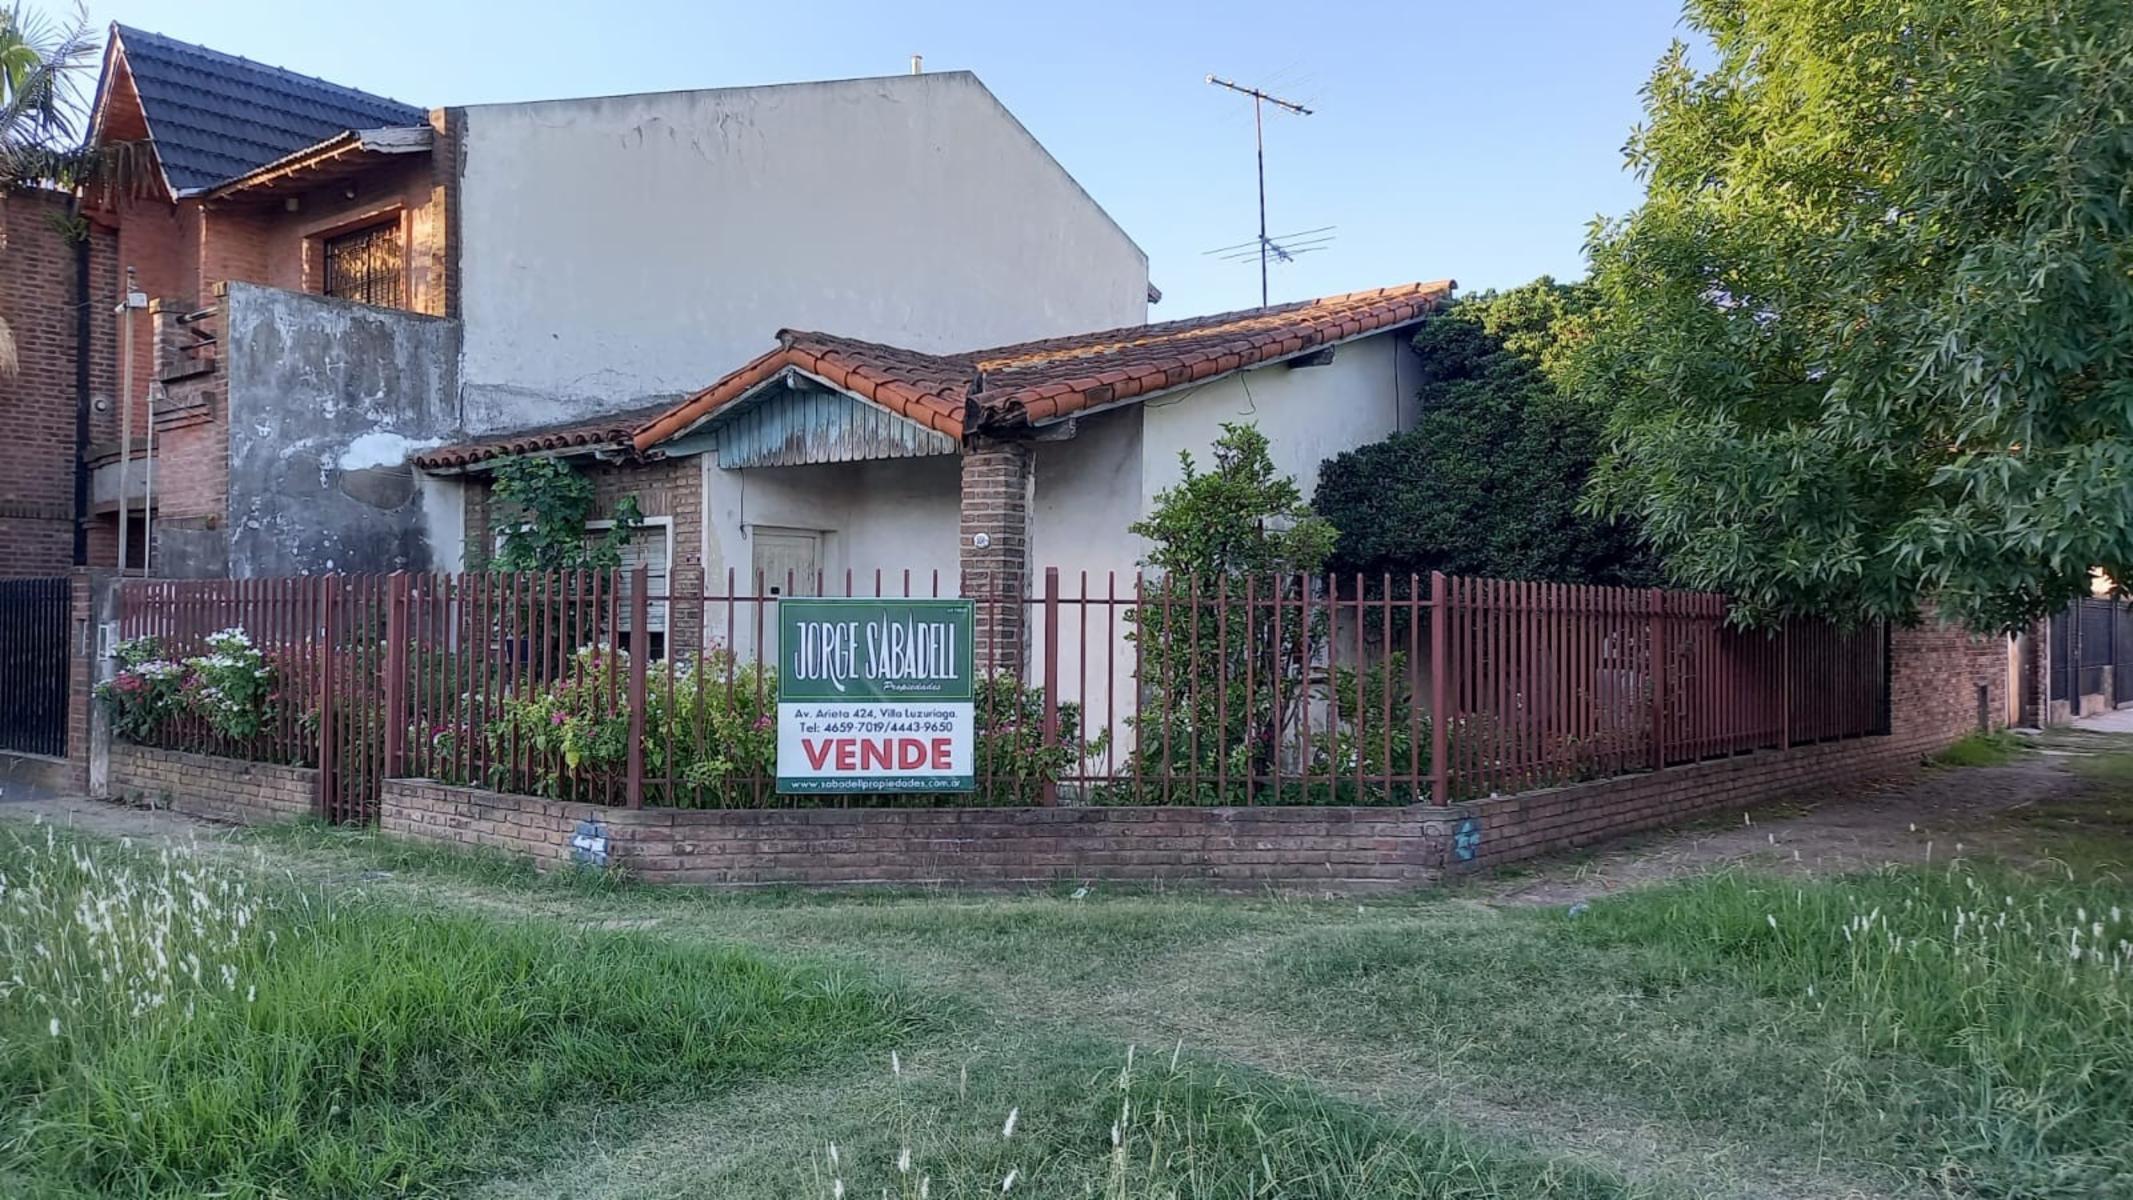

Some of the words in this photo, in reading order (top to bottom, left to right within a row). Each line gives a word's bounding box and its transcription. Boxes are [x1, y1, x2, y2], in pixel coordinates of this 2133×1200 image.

[794, 622, 859, 692] JORGE
[865, 609, 958, 679] SABADELL
[883, 681, 941, 691] Propiedades
[794, 709, 812, 719] Av.
[815, 709, 850, 719] Arieta
[852, 709, 877, 720] 424,
[880, 708, 902, 719] Villa
[800, 722, 820, 733] Tel:
[824, 722, 953, 733] 4659-7019/4443-9650
[801, 738, 953, 771] VENDE
[791, 779, 961, 790] www.sabadellpropiedades.com.ar
